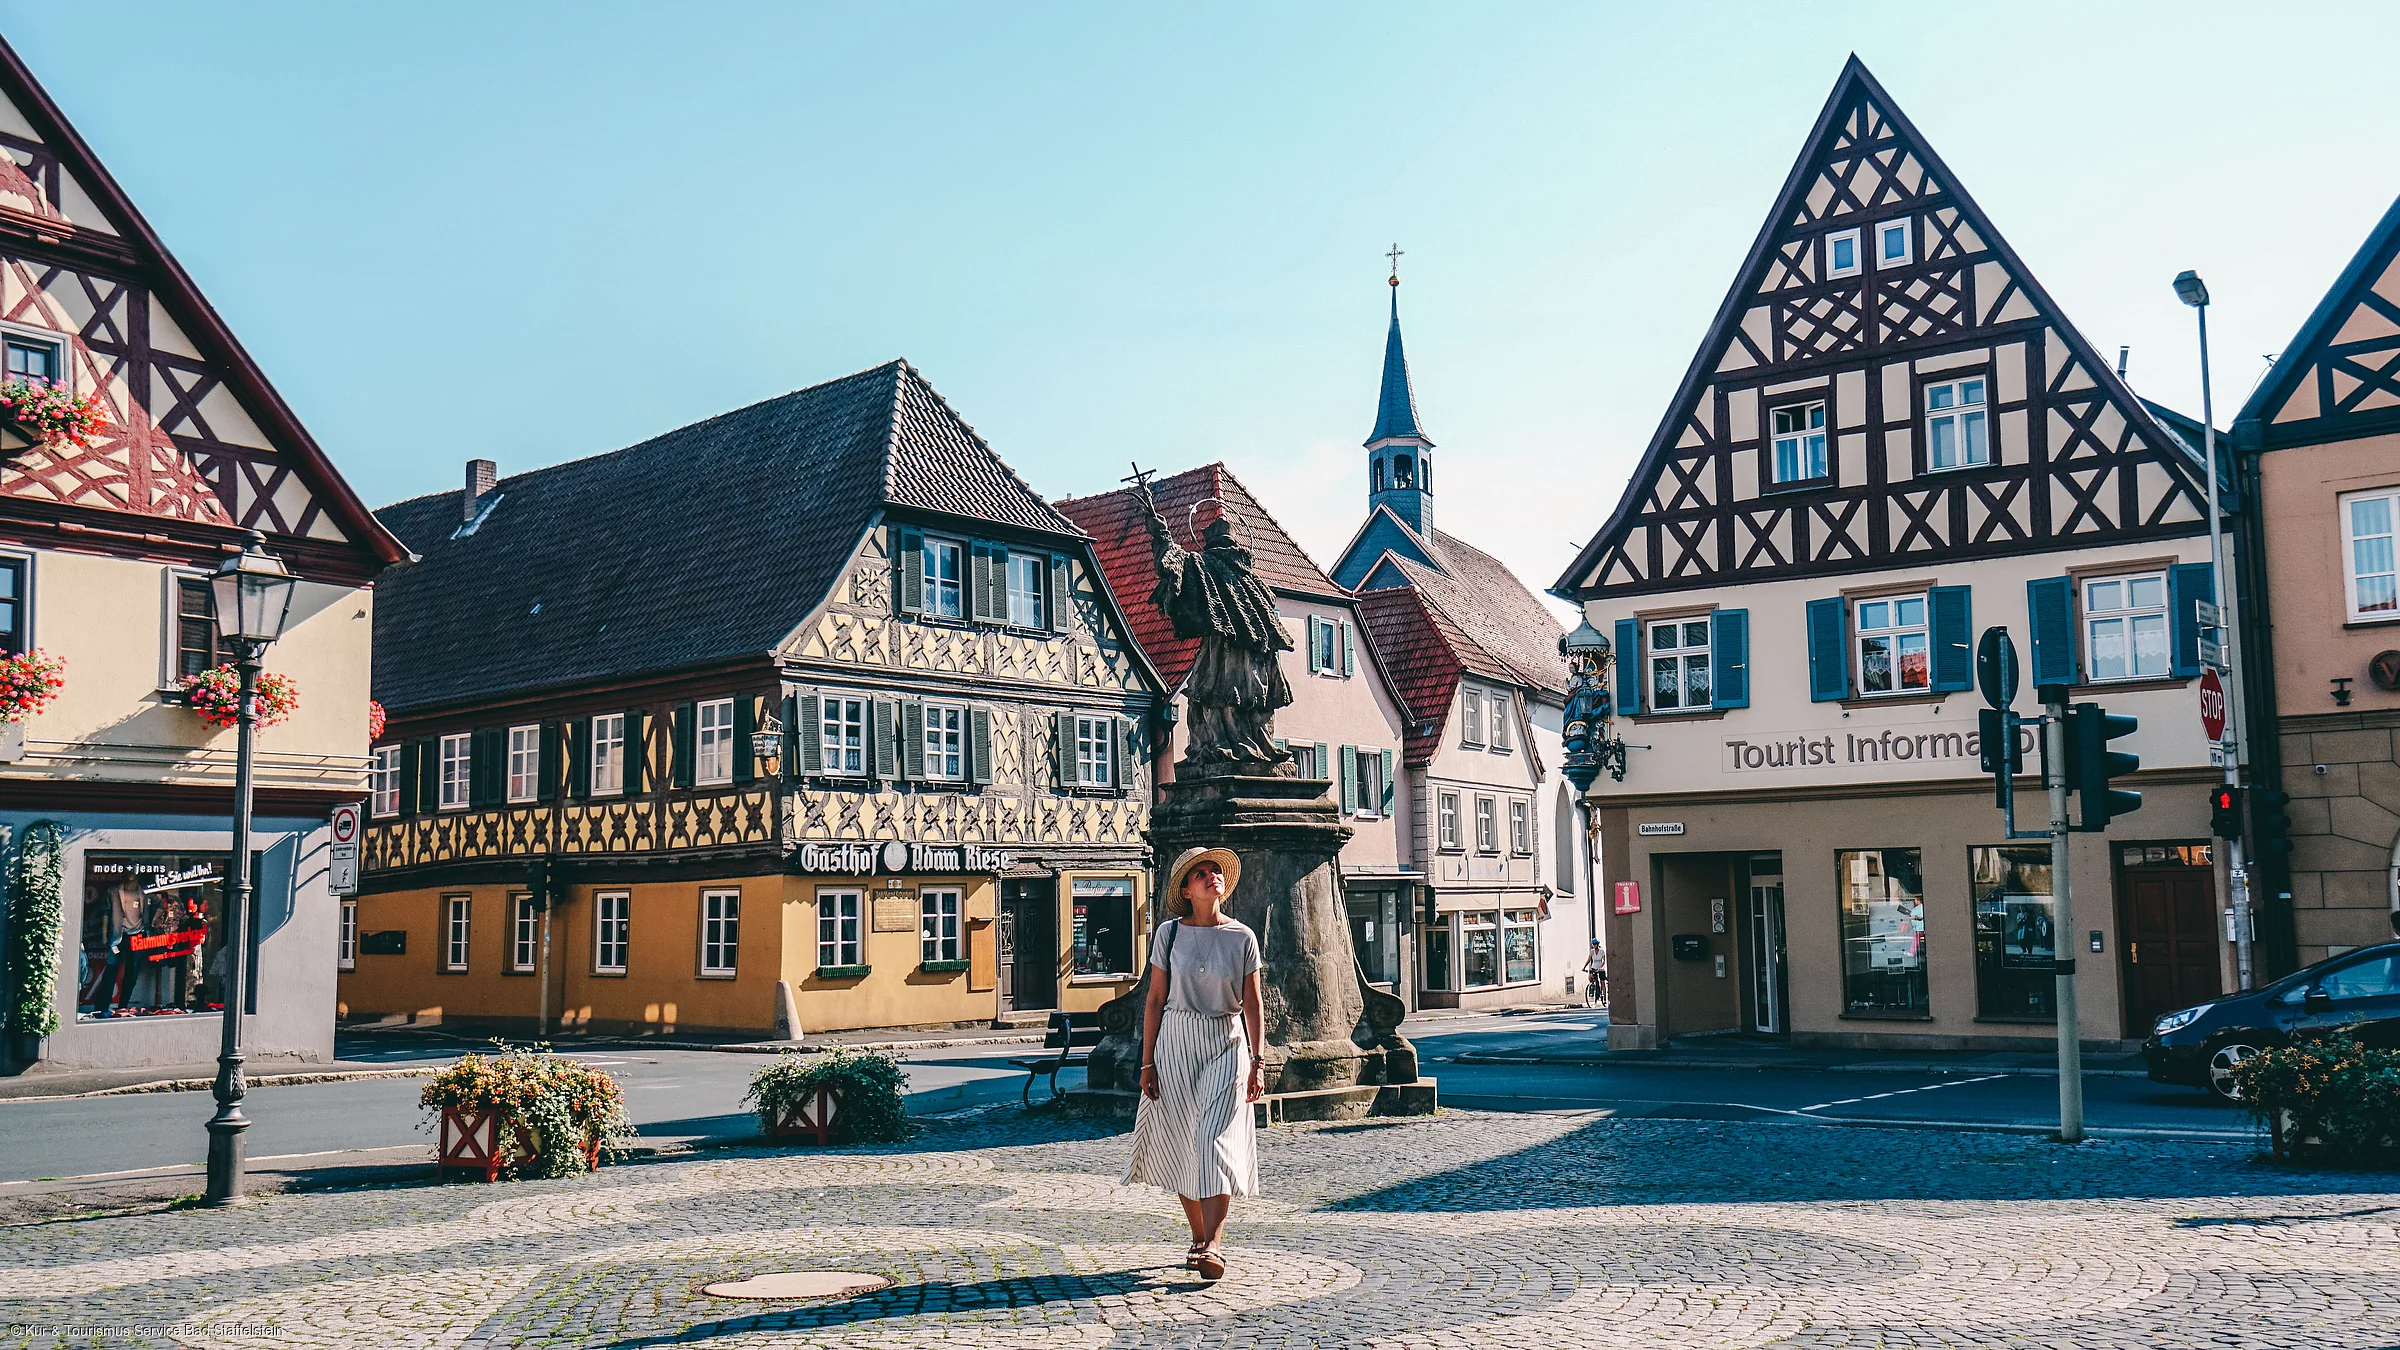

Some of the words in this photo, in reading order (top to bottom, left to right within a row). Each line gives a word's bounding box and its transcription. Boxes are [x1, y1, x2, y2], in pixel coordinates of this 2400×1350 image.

[2201, 688, 2223, 721] STOP
[1725, 735, 1836, 770] Tourist
[1641, 824, 1681, 833] Bahnhofstraße
[94, 864, 124, 873] mode
[135, 863, 166, 875] jeans
[800, 842, 880, 877] Gasthof
[910, 842, 961, 872] Adam
[963, 842, 1010, 871] Riese
[168, 870, 182, 883] Sie
